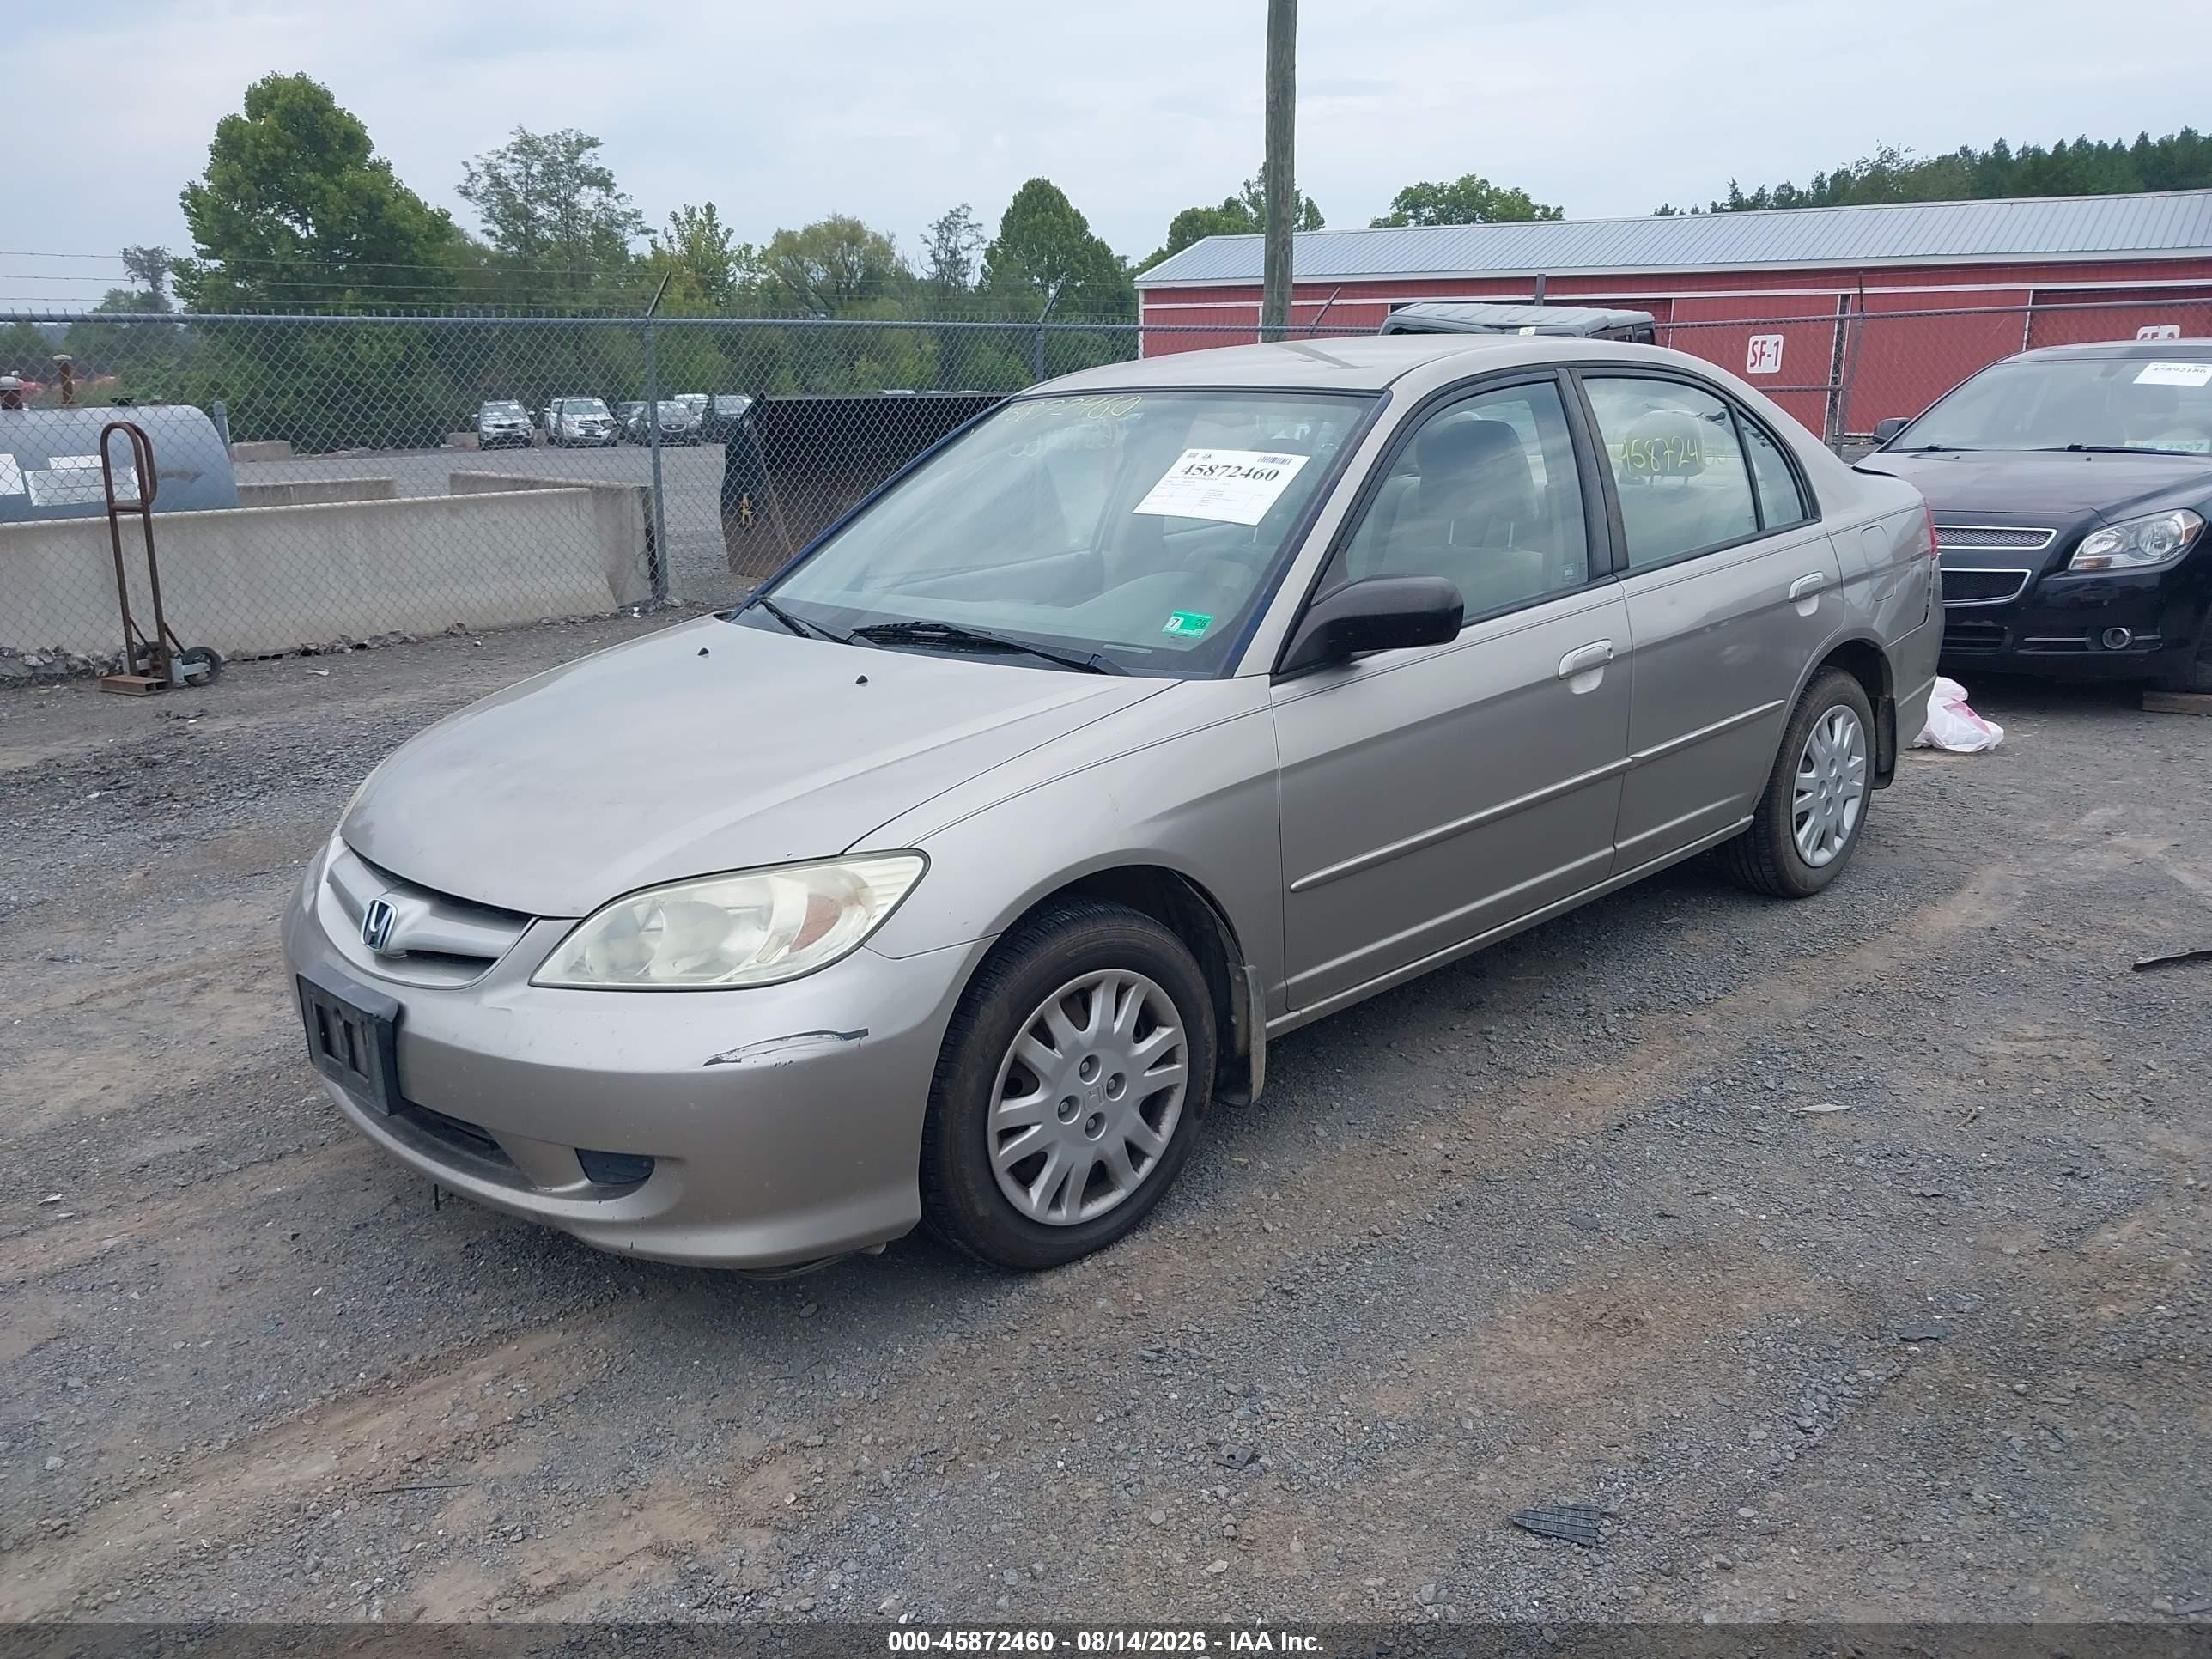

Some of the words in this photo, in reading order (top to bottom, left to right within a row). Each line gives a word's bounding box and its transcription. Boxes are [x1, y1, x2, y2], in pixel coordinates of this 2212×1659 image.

[1749, 340, 1780, 368] SF-1
[1000, 394, 1142, 422] 5872460
[1181, 463, 1280, 482] 45872460
